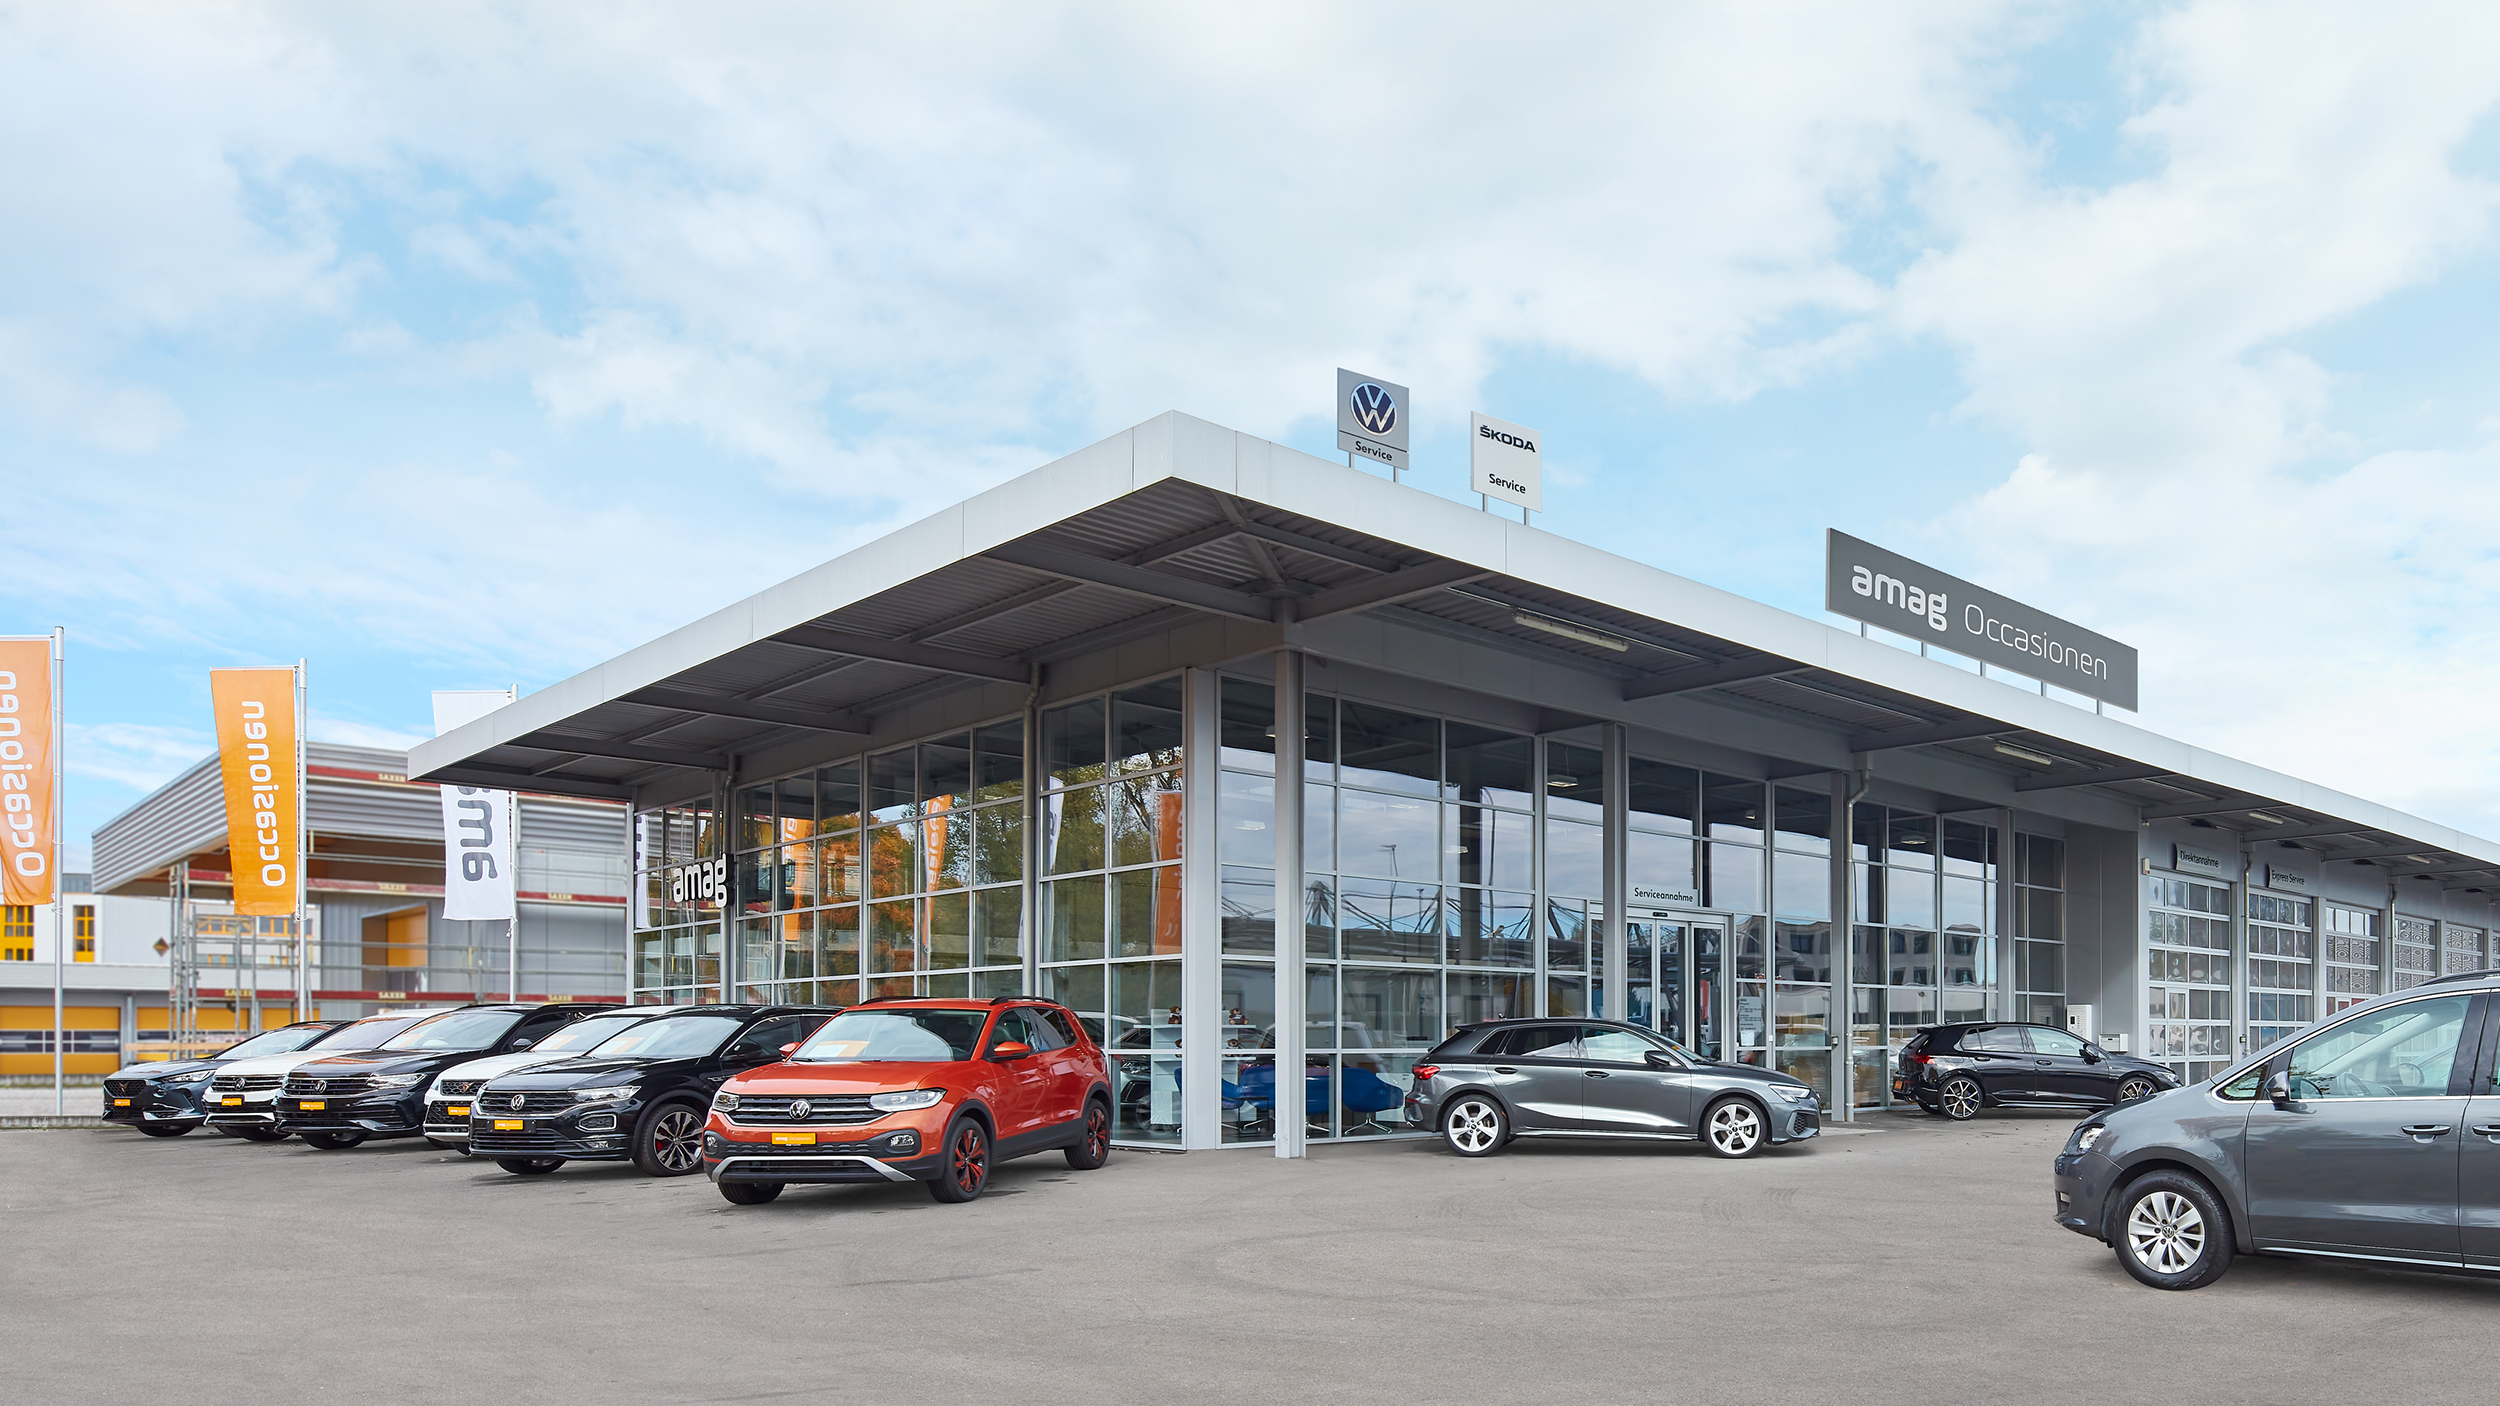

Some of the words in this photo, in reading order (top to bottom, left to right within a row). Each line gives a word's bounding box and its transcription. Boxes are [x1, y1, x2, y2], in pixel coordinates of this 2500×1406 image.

[1480, 425, 1536, 453] ŠKODA
[1355, 440, 1393, 461] Service
[1488, 473, 1526, 494] Service
[1851, 564, 1948, 632] amag
[1964, 603, 2108, 681] Occasionen
[2180, 850, 2219, 868] Direktannahme
[673, 852, 728, 908] amag
[1634, 887, 1694, 903] Serviceannahme
